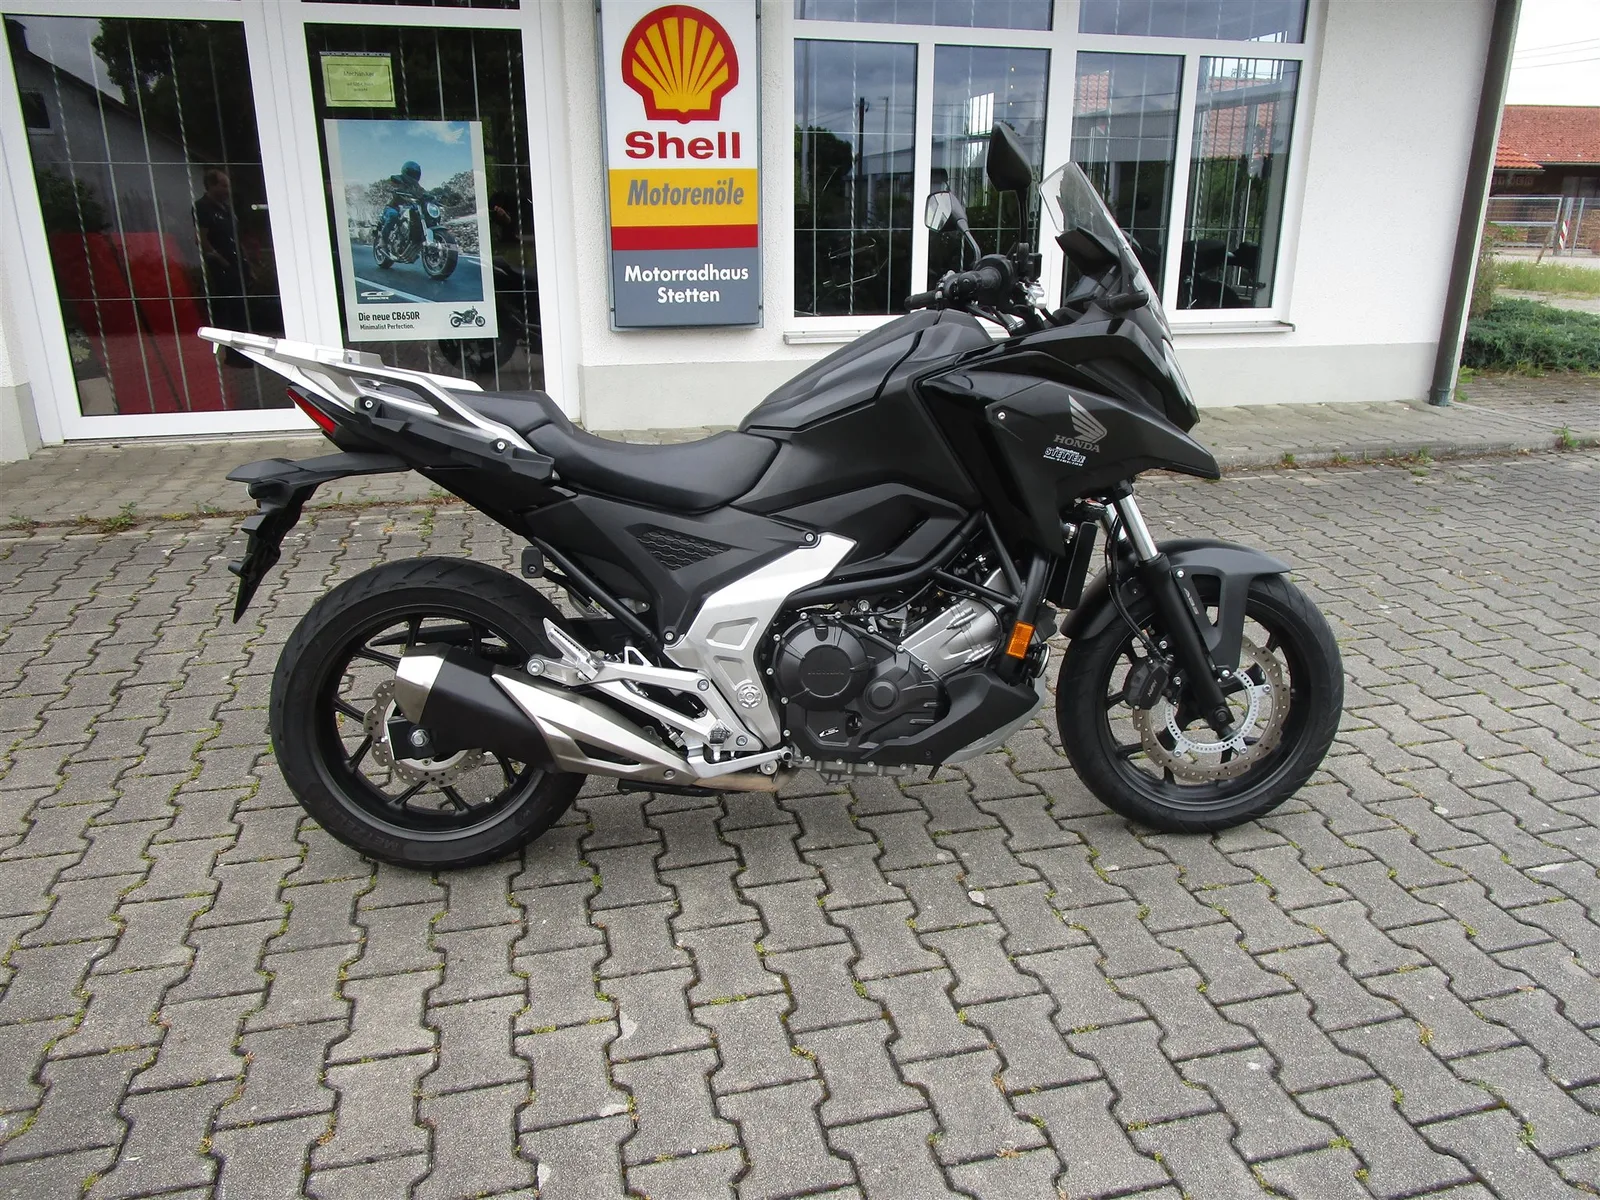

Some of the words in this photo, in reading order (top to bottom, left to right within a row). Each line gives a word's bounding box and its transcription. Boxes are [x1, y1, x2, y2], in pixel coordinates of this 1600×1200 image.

[625, 131, 741, 159] Shell
[627, 177, 744, 206] Motorenöle
[624, 263, 749, 283] Motorradhaus
[657, 286, 720, 304] Stetten
[358, 312, 371, 322] Die
[372, 313, 391, 321] neue
[391, 311, 420, 321] CB650R
[1053, 434, 1100, 453] HONDA
[1044, 447, 1087, 464] STETTEN
